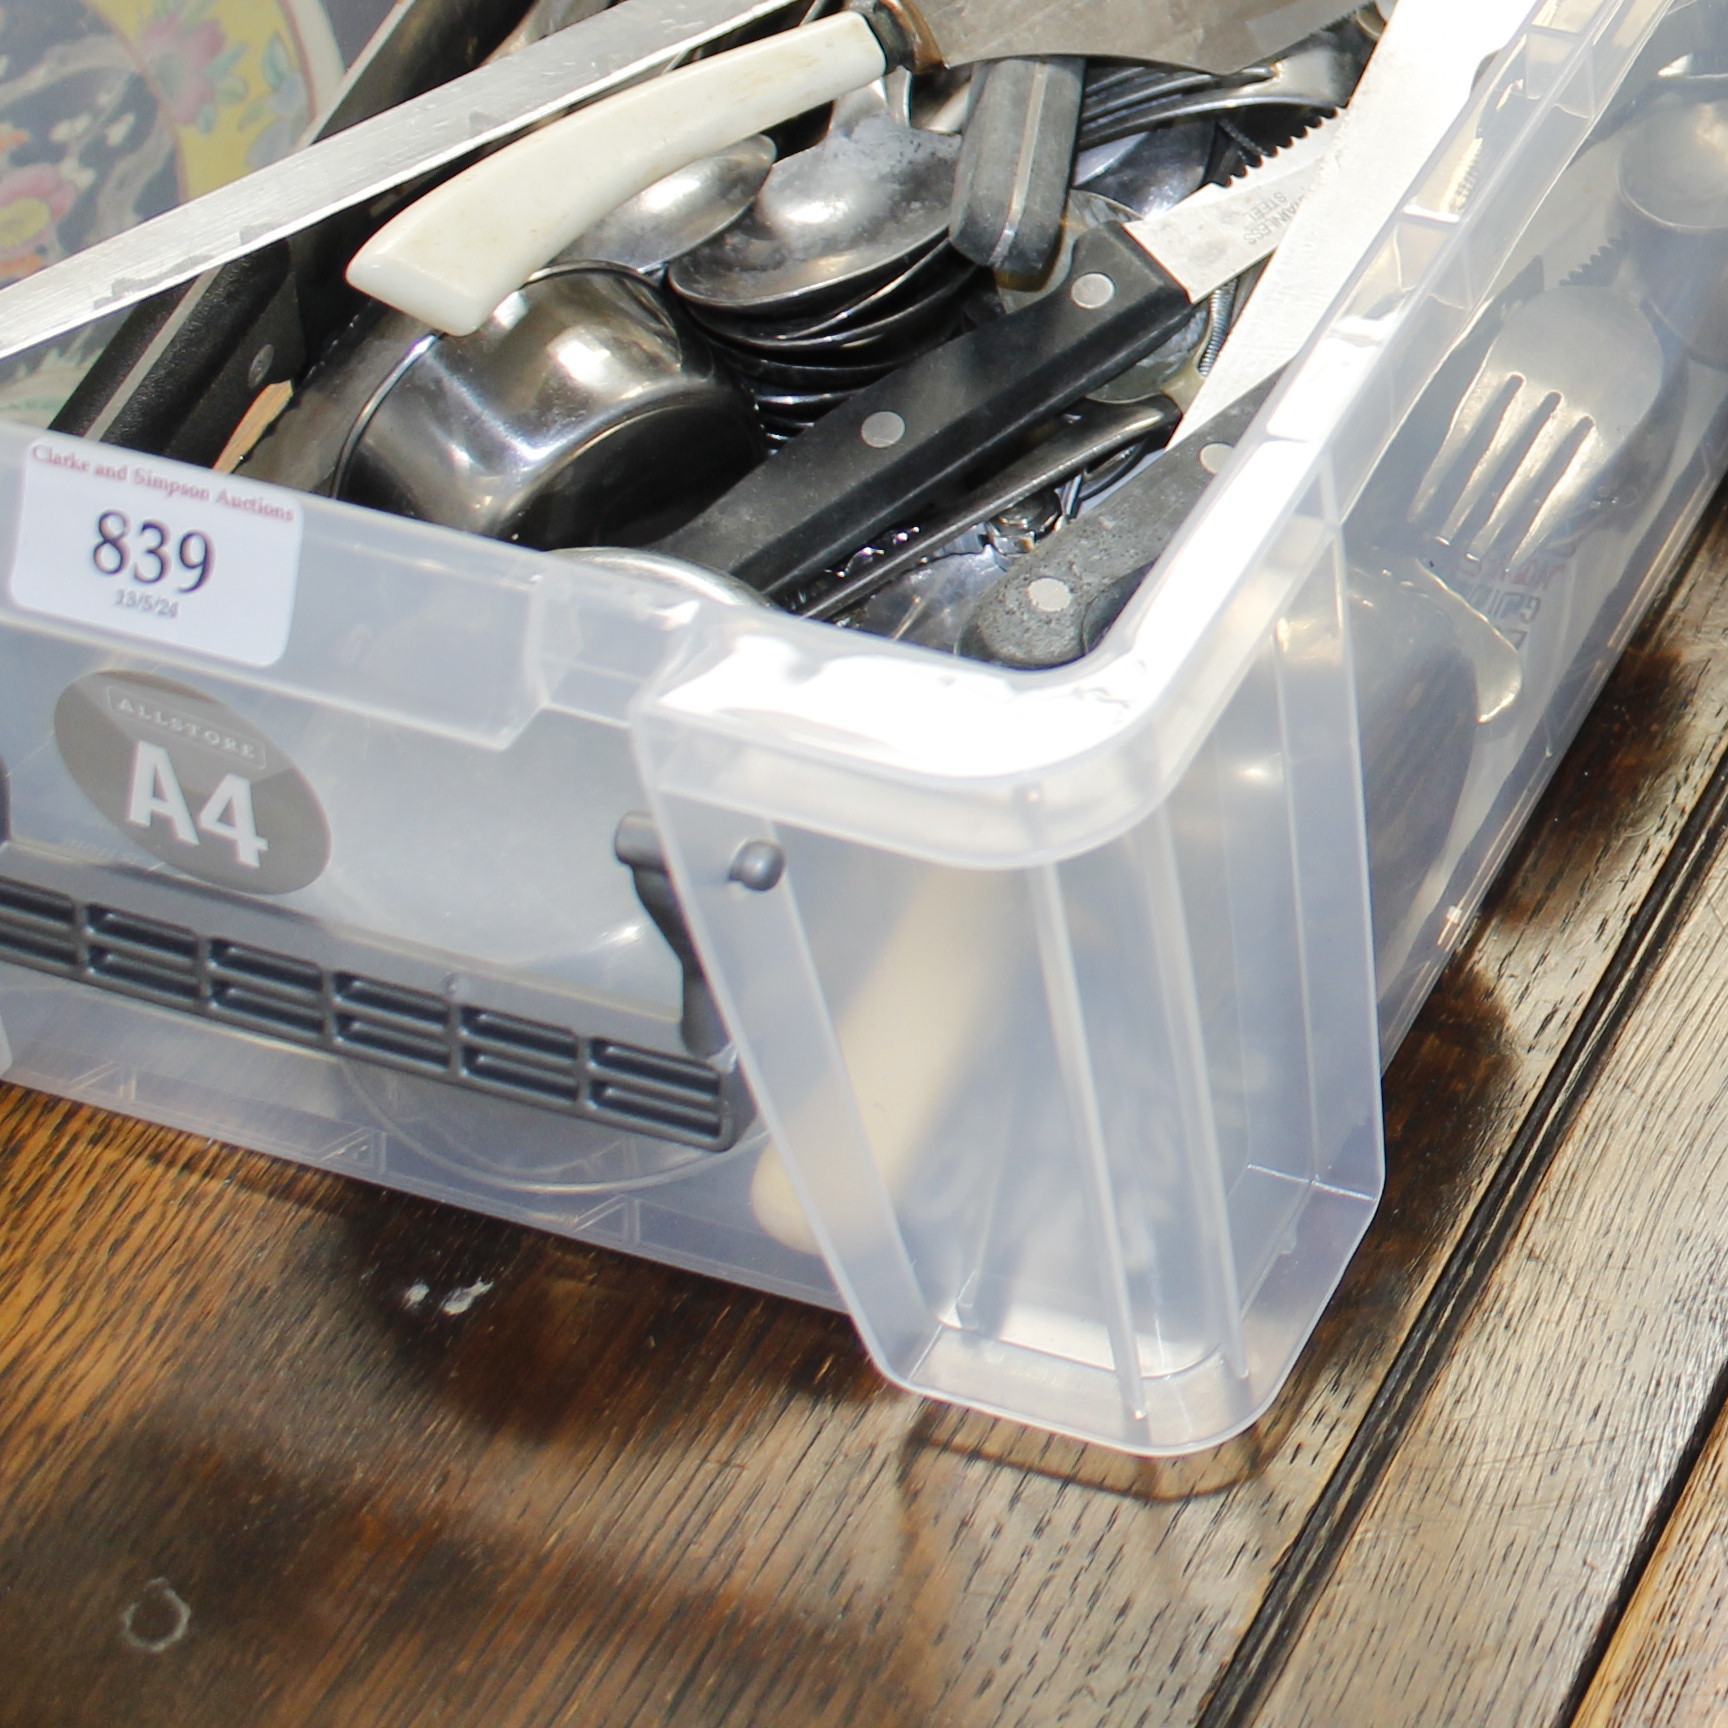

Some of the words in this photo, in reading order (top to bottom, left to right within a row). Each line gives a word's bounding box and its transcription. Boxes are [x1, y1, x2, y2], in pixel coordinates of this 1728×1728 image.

[1244, 192, 1288, 223] STEEL
[32, 443, 91, 472] Clarke
[95, 459, 128, 481] and
[133, 466, 210, 500] Simpson
[215, 489, 294, 522] Auctions
[92, 509, 215, 594] 839
[115, 588, 180, 619] 13/5/24
[119, 697, 256, 759] ALLSTORE
[127, 739, 269, 869] A4
